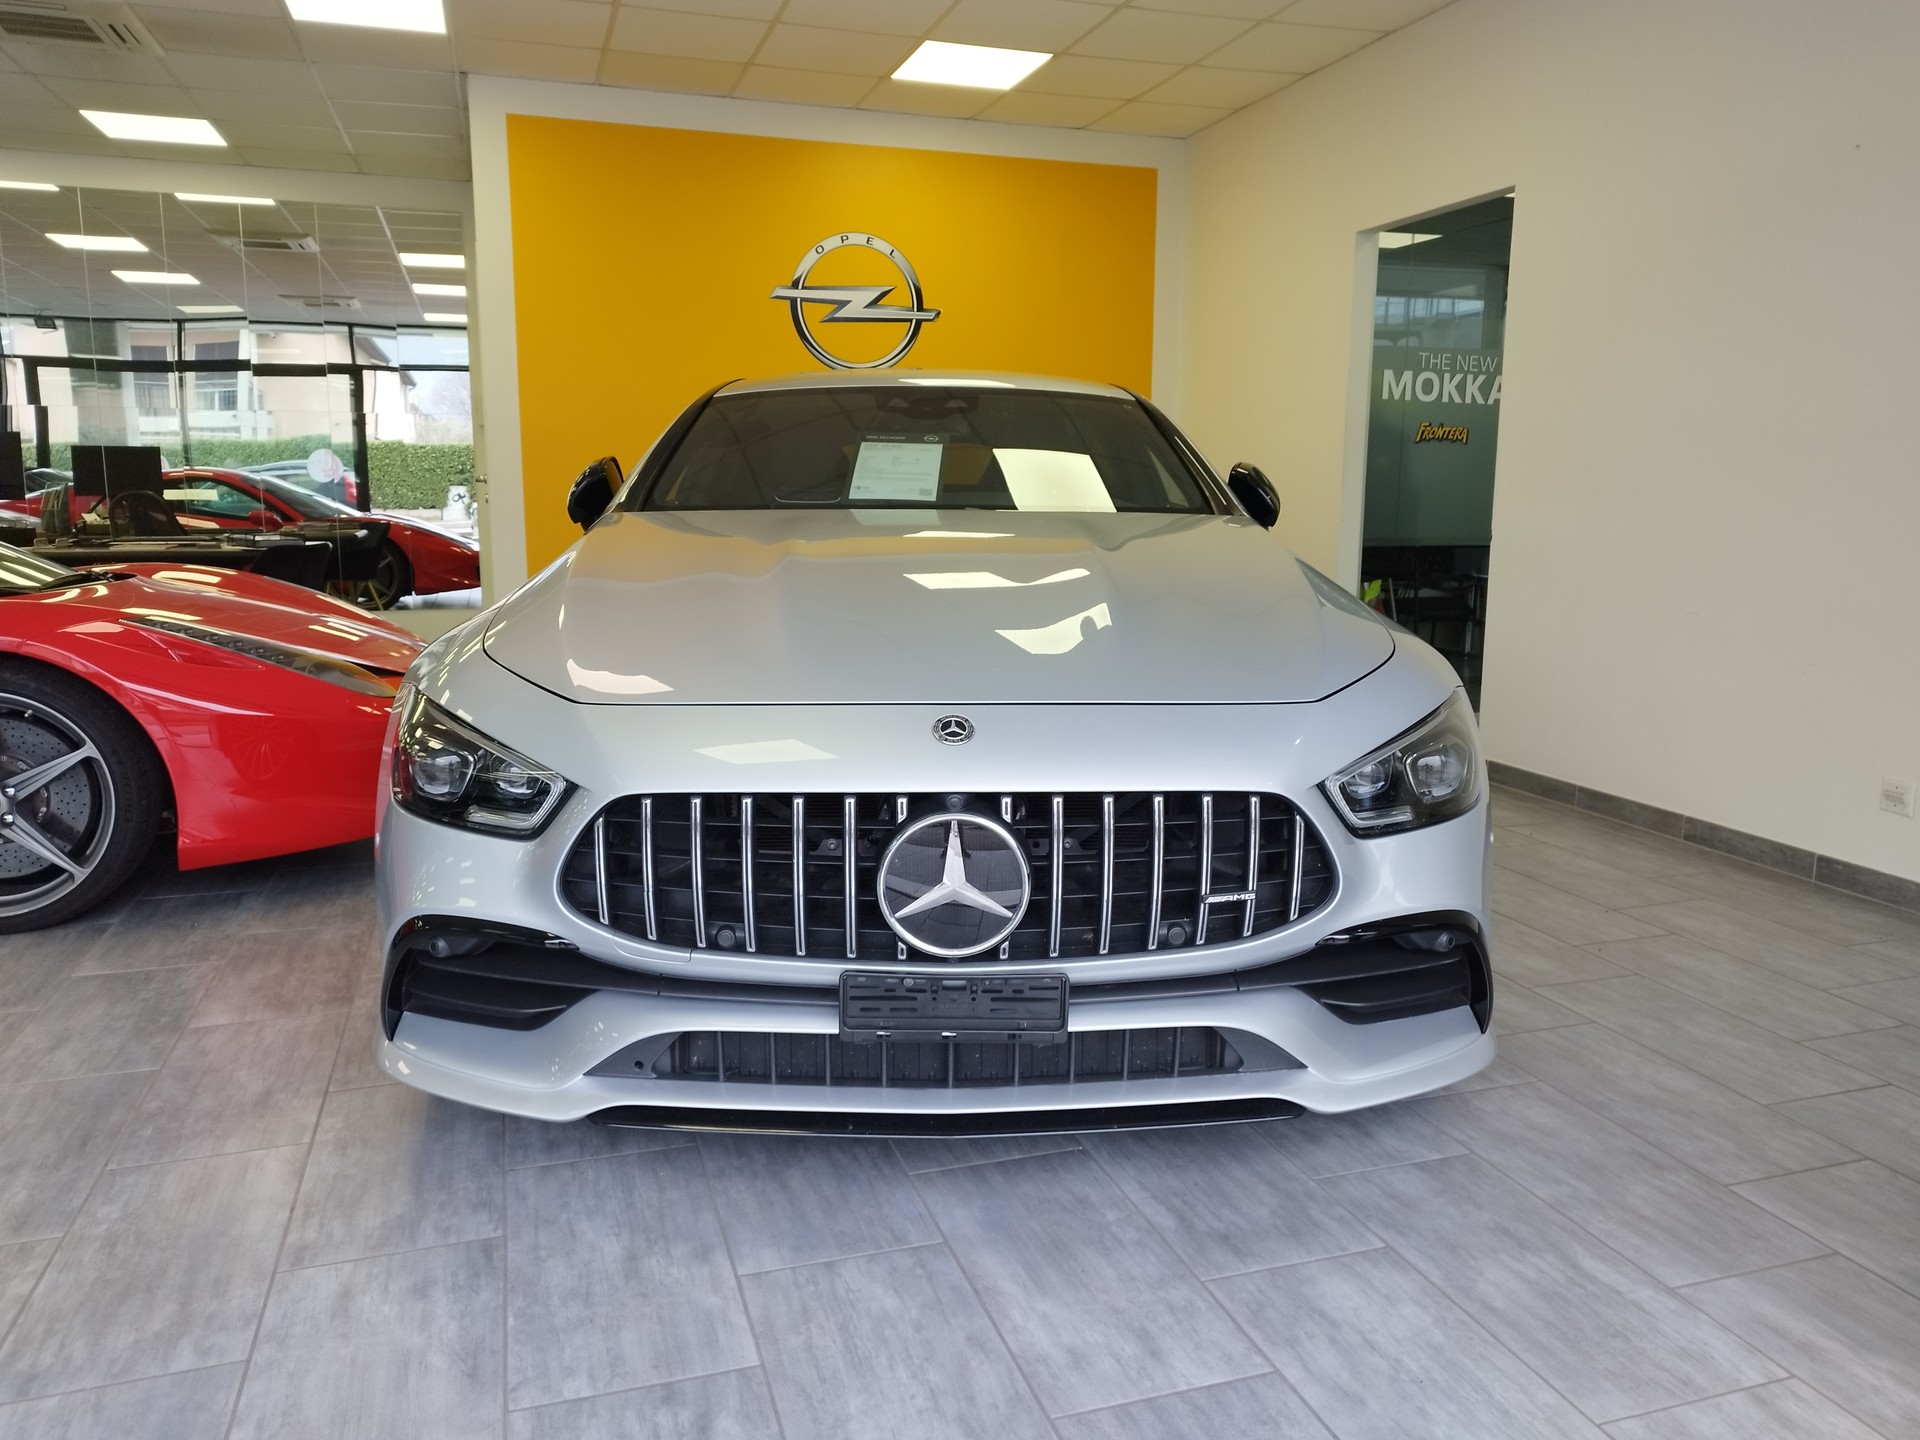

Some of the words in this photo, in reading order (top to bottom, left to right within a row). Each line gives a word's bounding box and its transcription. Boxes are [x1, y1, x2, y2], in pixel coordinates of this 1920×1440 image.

[815, 234, 896, 258] OPEL
[1419, 352, 1452, 370] THE
[1457, 354, 1498, 372] NEW
[1416, 421, 1469, 444] FRONTERA
[1218, 893, 1256, 902] AMG
